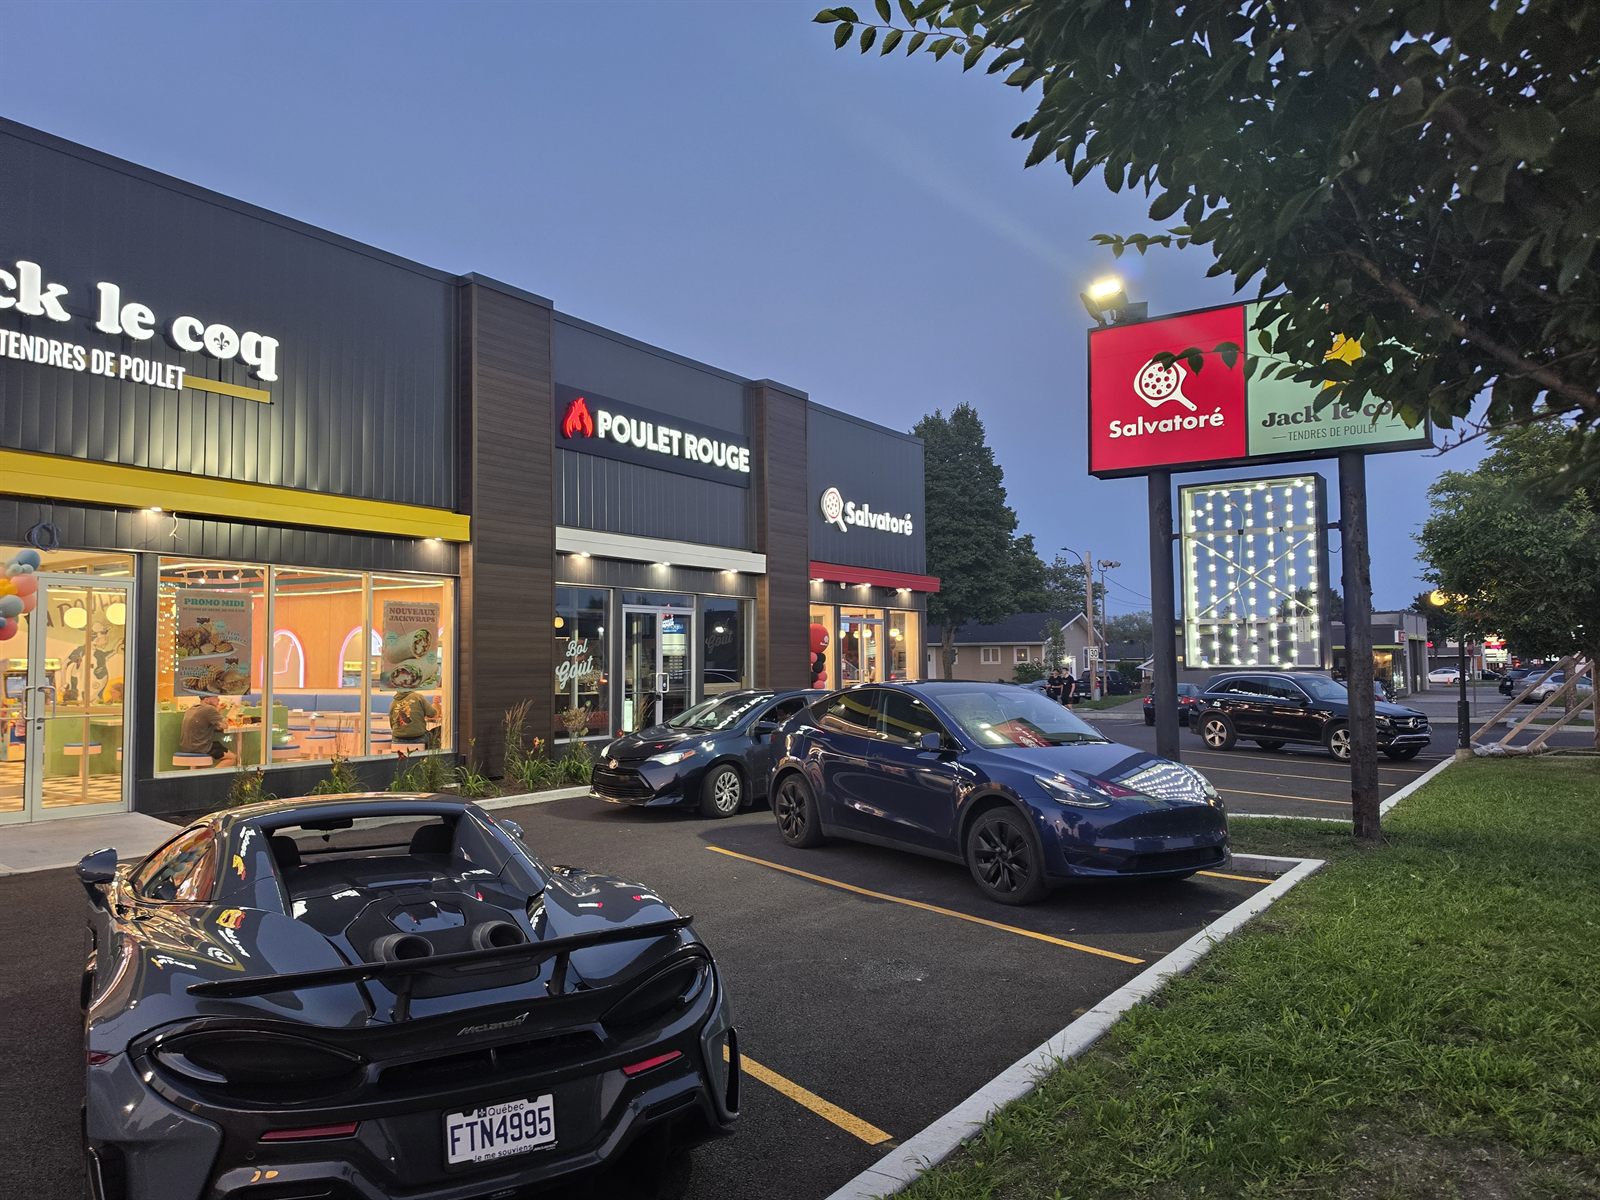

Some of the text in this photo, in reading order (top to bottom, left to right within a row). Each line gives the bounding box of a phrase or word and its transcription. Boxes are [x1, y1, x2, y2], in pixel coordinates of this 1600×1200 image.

[96, 282, 155, 340] le
[172, 316, 279, 381] coq
[0, 328, 186, 390] TENDRES DE POULET
[1109, 406, 1225, 438] Salvatoré
[1261, 405, 1322, 428] Jack
[598, 410, 750, 473] POULET ROUGE
[1287, 423, 1379, 441] TENDRES DE POULET
[844, 501, 913, 536] Salvatoré
[184, 597, 220, 606] PROMO
[389, 607, 436, 616] NOUVEAUX
[389, 615, 436, 623] JACKWRAPS
[566, 638, 589, 657] Bol
[1090, 649, 1098, 658] 30
[457, 1016, 526, 1036] McLaren
[487, 1102, 525, 1117] Québec
[450, 1106, 552, 1156] FTN4995
[484, 1152, 496, 1160] me
[497, 1144, 533, 1157] souviens
